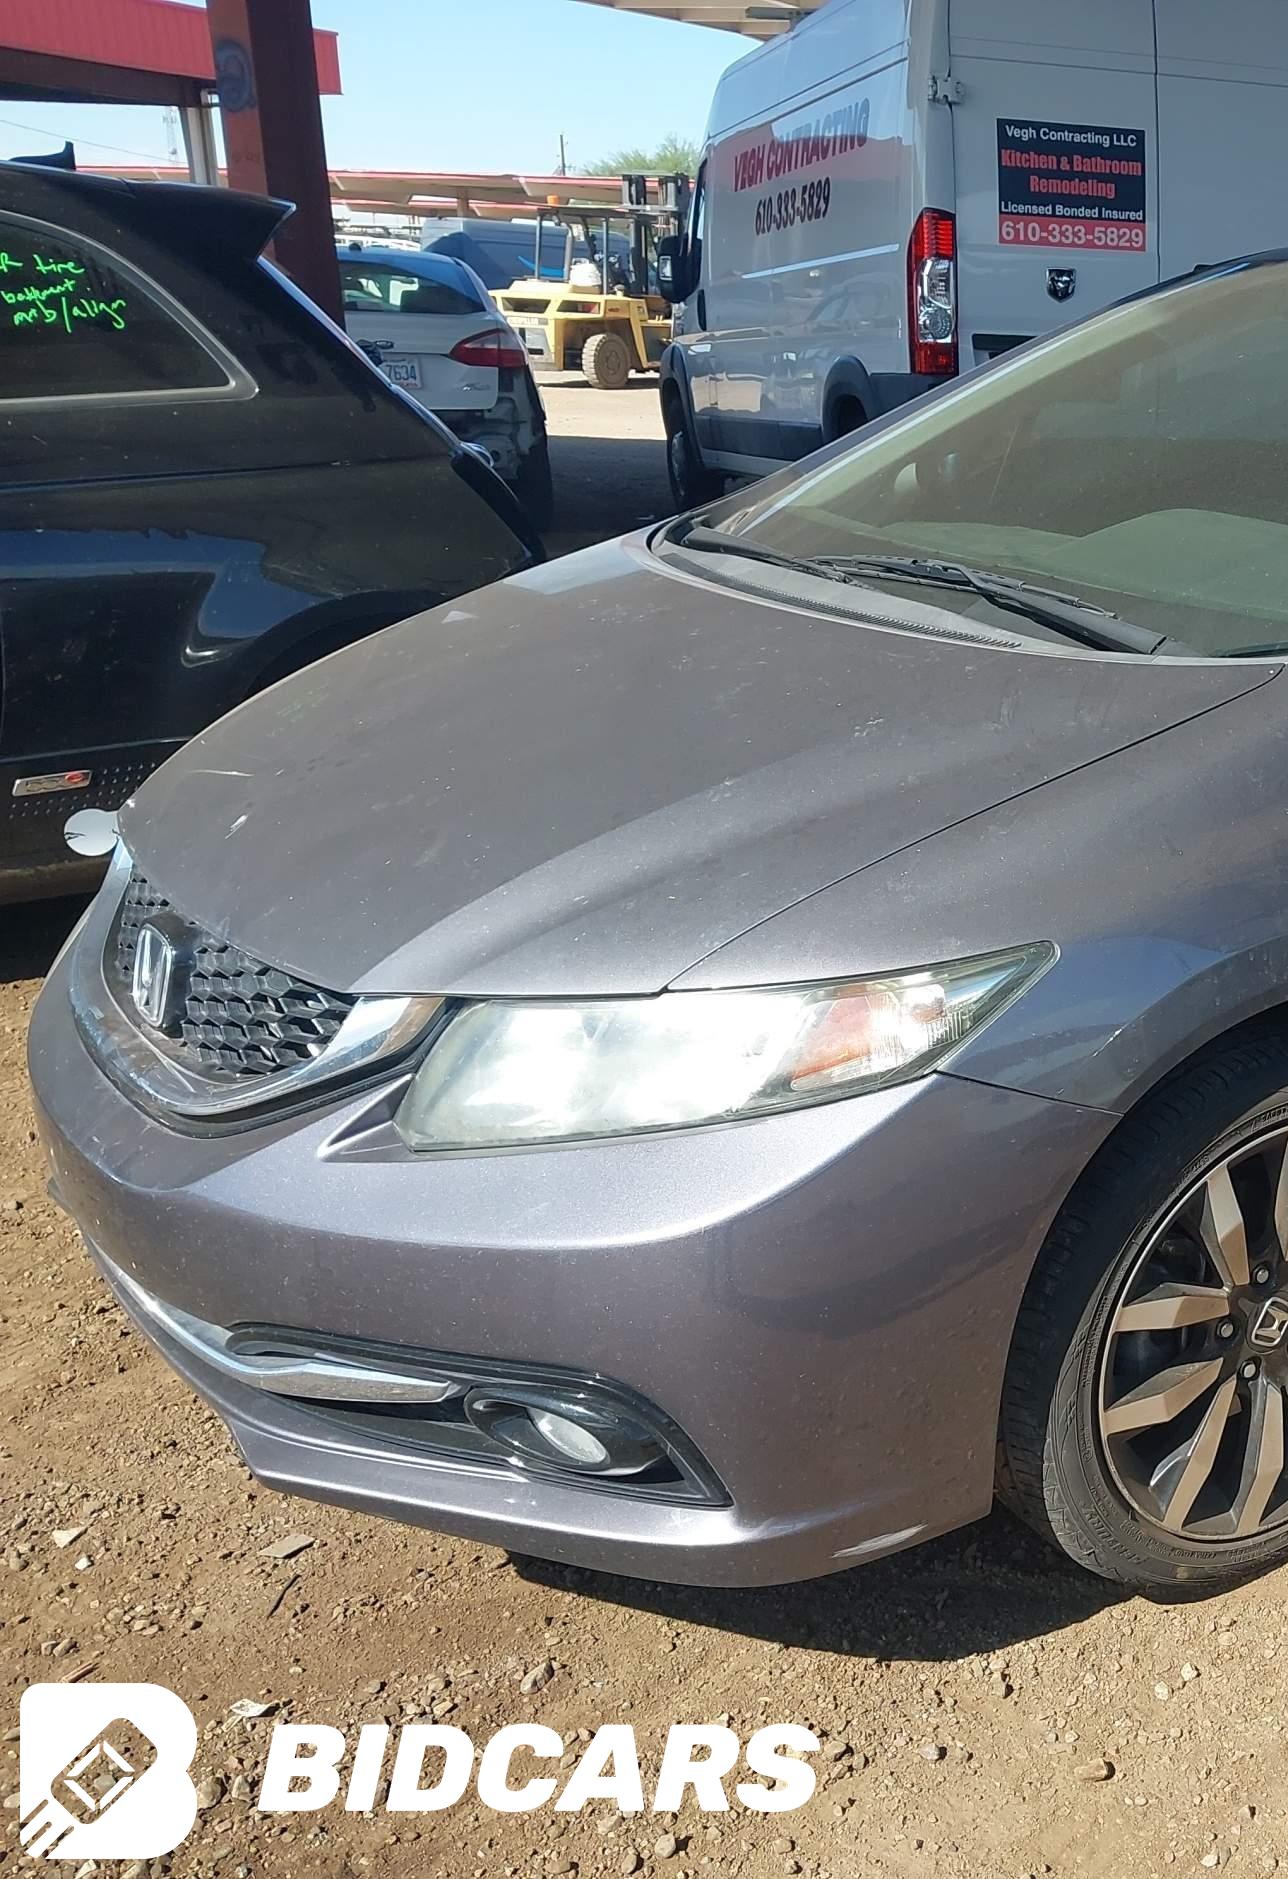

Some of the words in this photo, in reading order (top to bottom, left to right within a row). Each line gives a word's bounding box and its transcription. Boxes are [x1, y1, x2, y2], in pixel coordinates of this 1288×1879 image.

[766, 97, 870, 180] CONTRACTING
[1005, 124, 1037, 141] Vegh
[1039, 127, 1110, 148] Contracting
[1113, 133, 1137, 147] LLC
[1001, 148, 1057, 170] Kitchen
[1060, 155, 1070, 171] &
[1072, 154, 1142, 176] Bathroom
[1029, 175, 1116, 199] Remodeling
[755, 176, 831, 236] 610-333-5829
[1001, 201, 1052, 215] Licensed
[1055, 204, 1099, 218] Bonded
[1101, 207, 1144, 221] Insured
[1001, 220, 1144, 248] 610-333-5829
